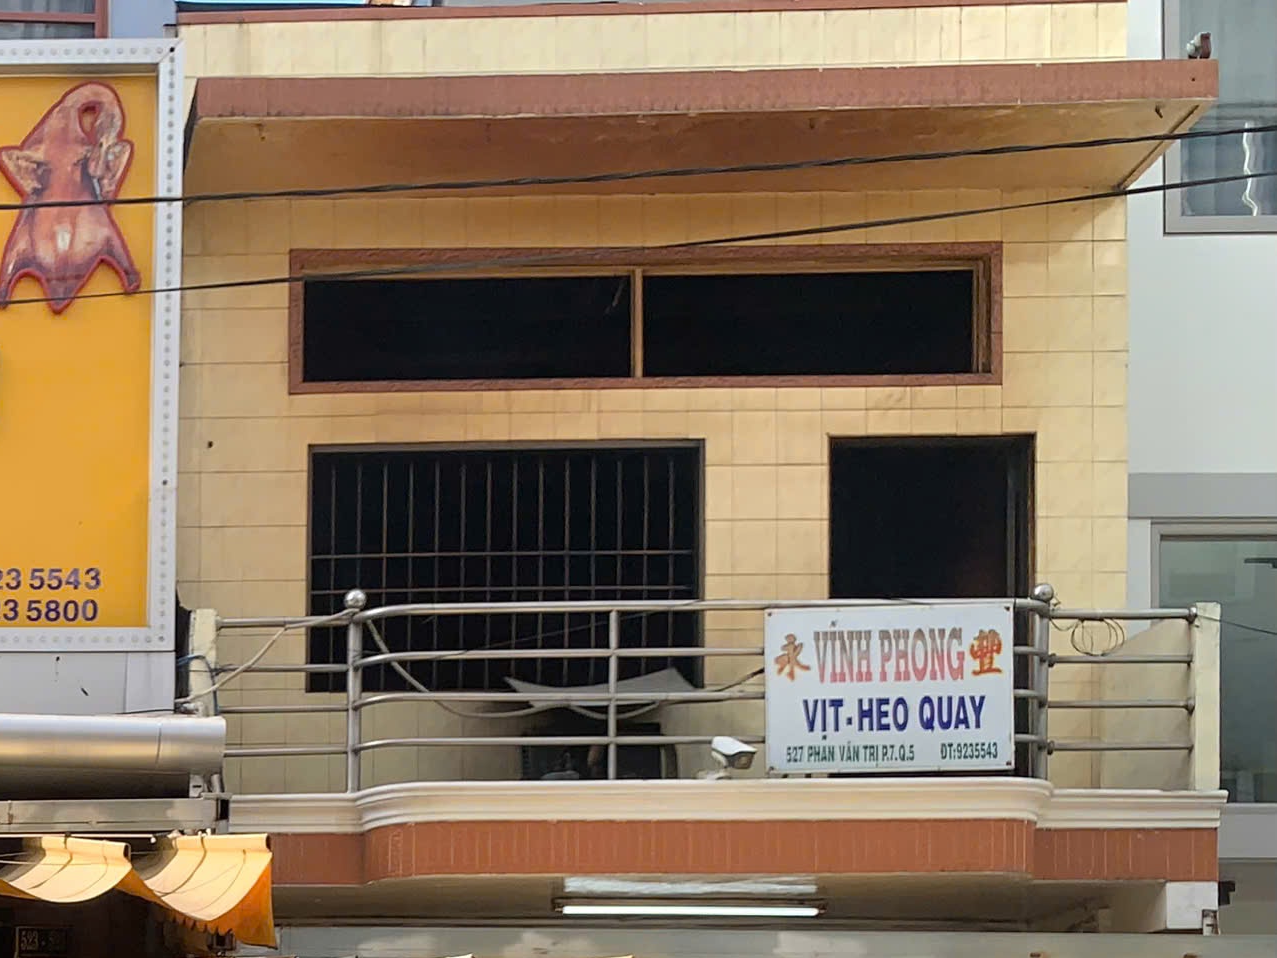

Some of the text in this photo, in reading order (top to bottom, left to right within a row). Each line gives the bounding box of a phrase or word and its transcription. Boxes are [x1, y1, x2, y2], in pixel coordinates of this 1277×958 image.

[29, 567, 101, 590] 5543
[26, 599, 99, 622] 5800
[775, 633, 810, 680] 永
[878, 627, 965, 682] PHONG
[919, 695, 986, 733] QUAY
[786, 746, 804, 763] 527
[807, 745, 835, 762] PHAN
[862, 744, 879, 768] TRỊ
